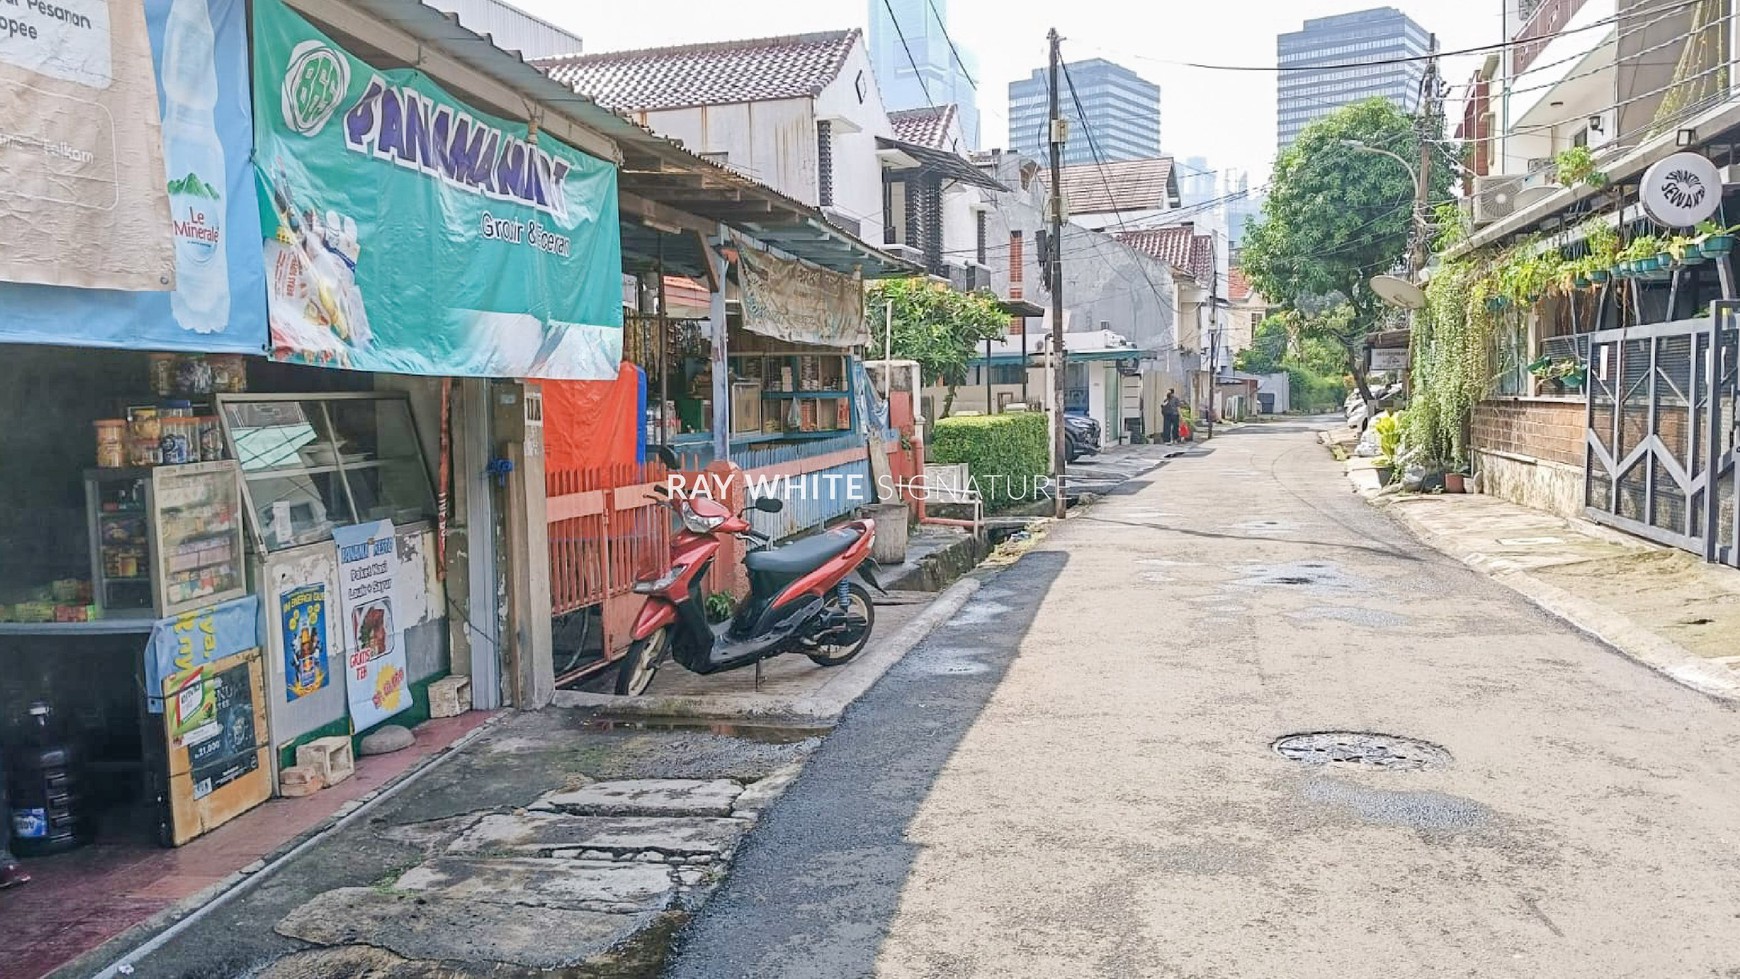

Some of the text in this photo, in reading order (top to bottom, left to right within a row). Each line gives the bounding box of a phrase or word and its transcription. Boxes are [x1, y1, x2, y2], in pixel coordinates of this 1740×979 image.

[189, 205, 204, 225] Le
[173, 220, 219, 243] Minerale
[529, 220, 536, 245] &
